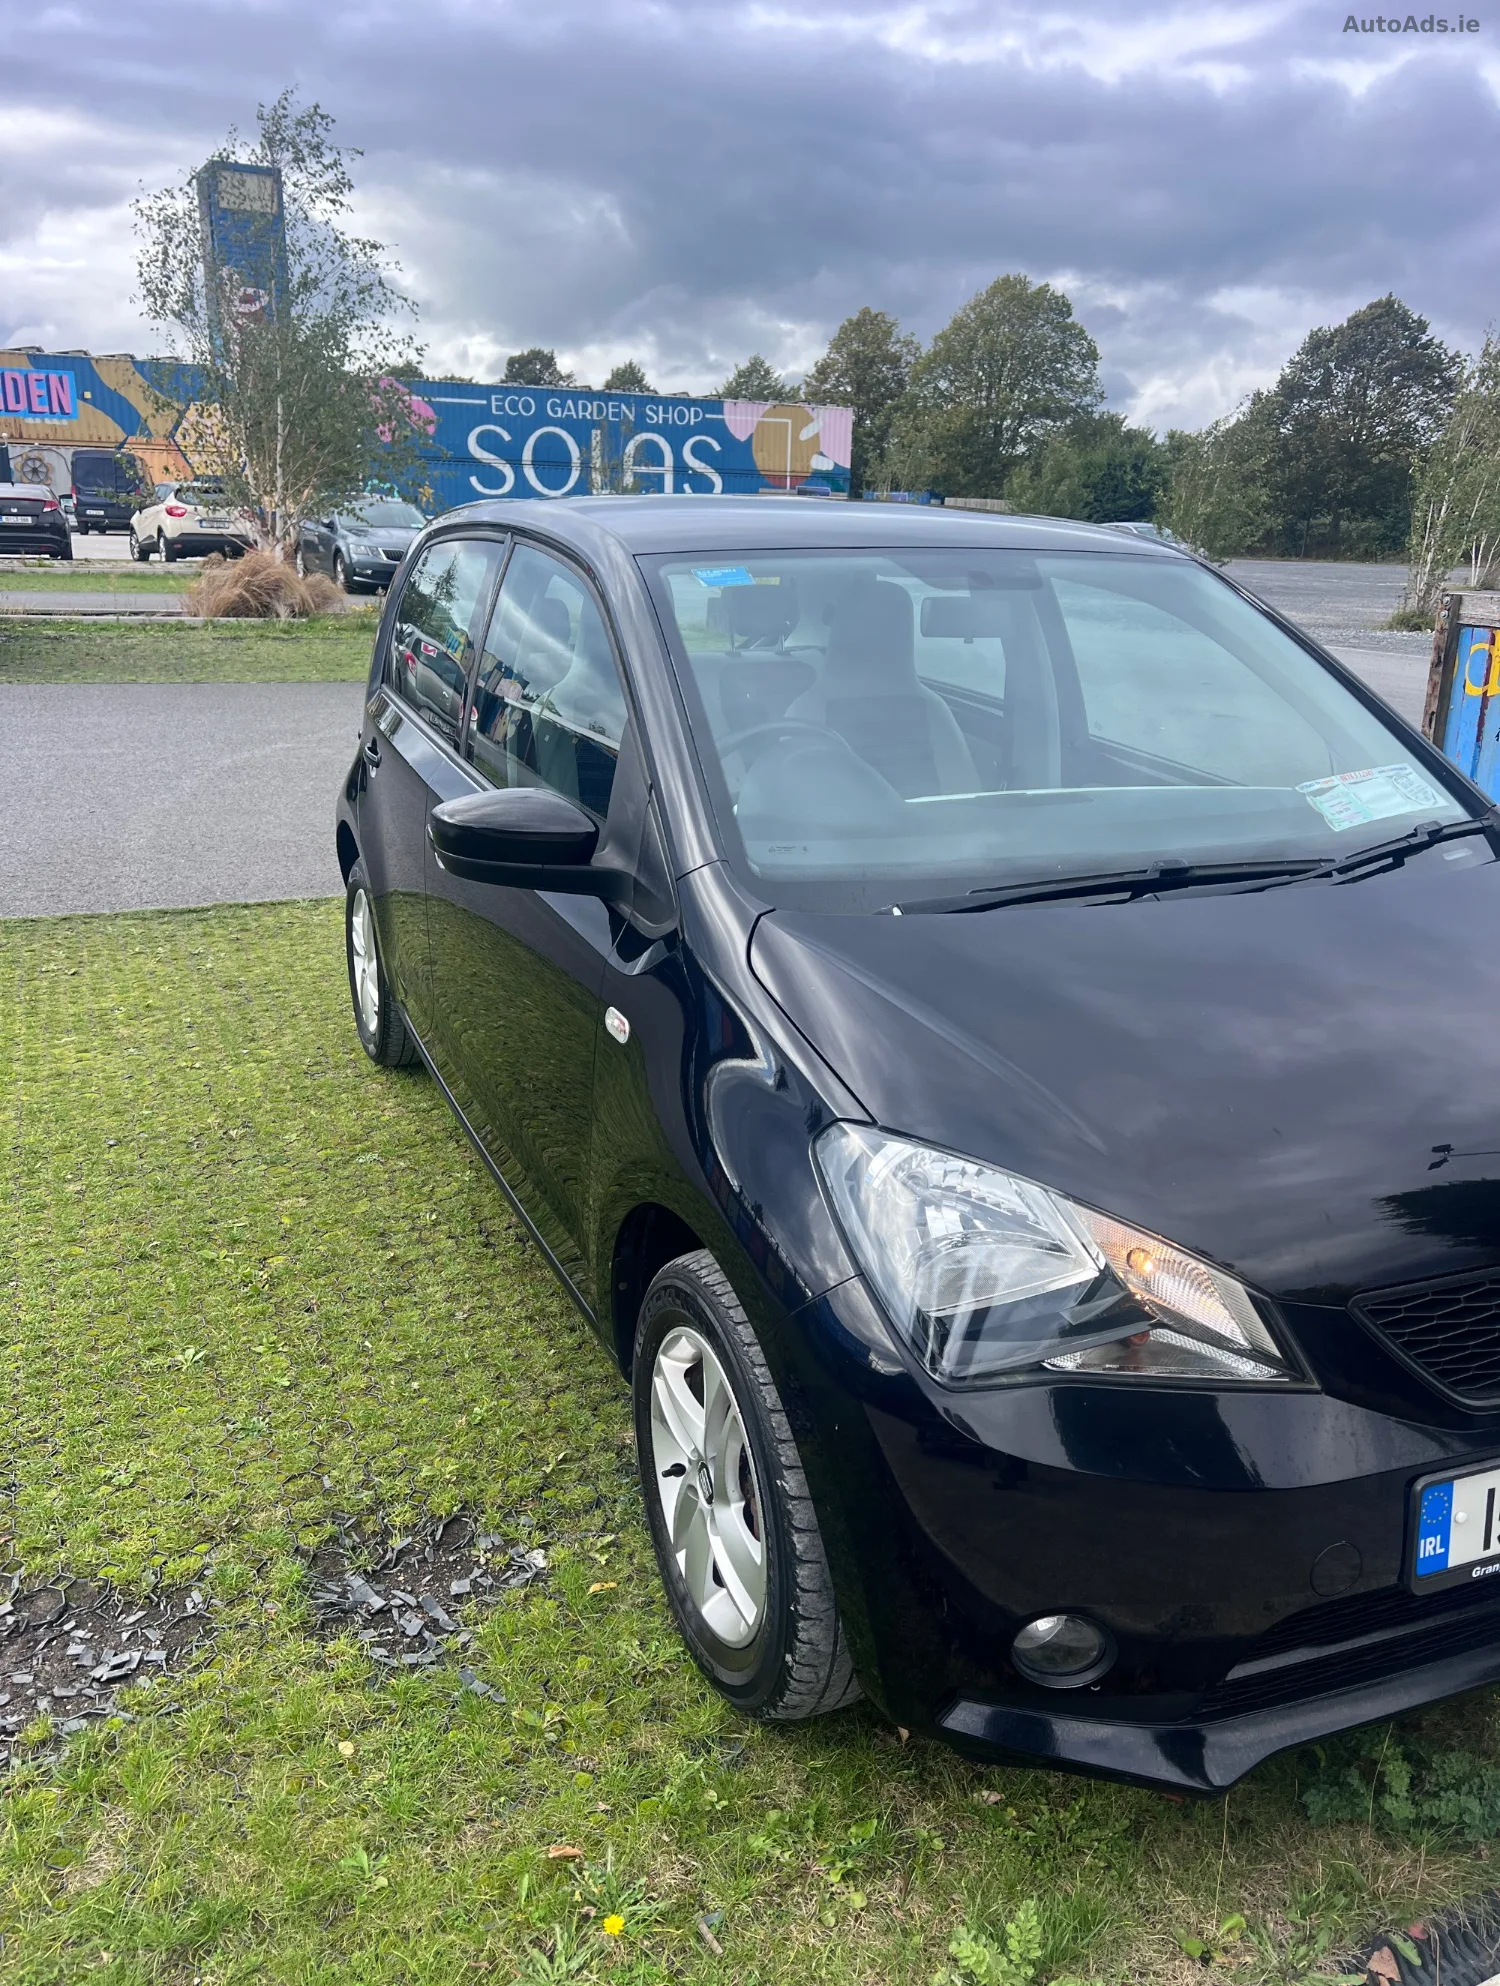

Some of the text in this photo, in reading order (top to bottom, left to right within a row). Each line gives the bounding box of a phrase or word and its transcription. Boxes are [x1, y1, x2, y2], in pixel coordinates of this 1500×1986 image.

[0, 371, 72, 415] DEN
[491, 394, 704, 426] ECO GARDEN SHOP
[1483, 1487, 1500, 1551] 1
[1419, 1535, 1445, 1559] IRL
[1471, 1563, 1500, 1577] Gran
